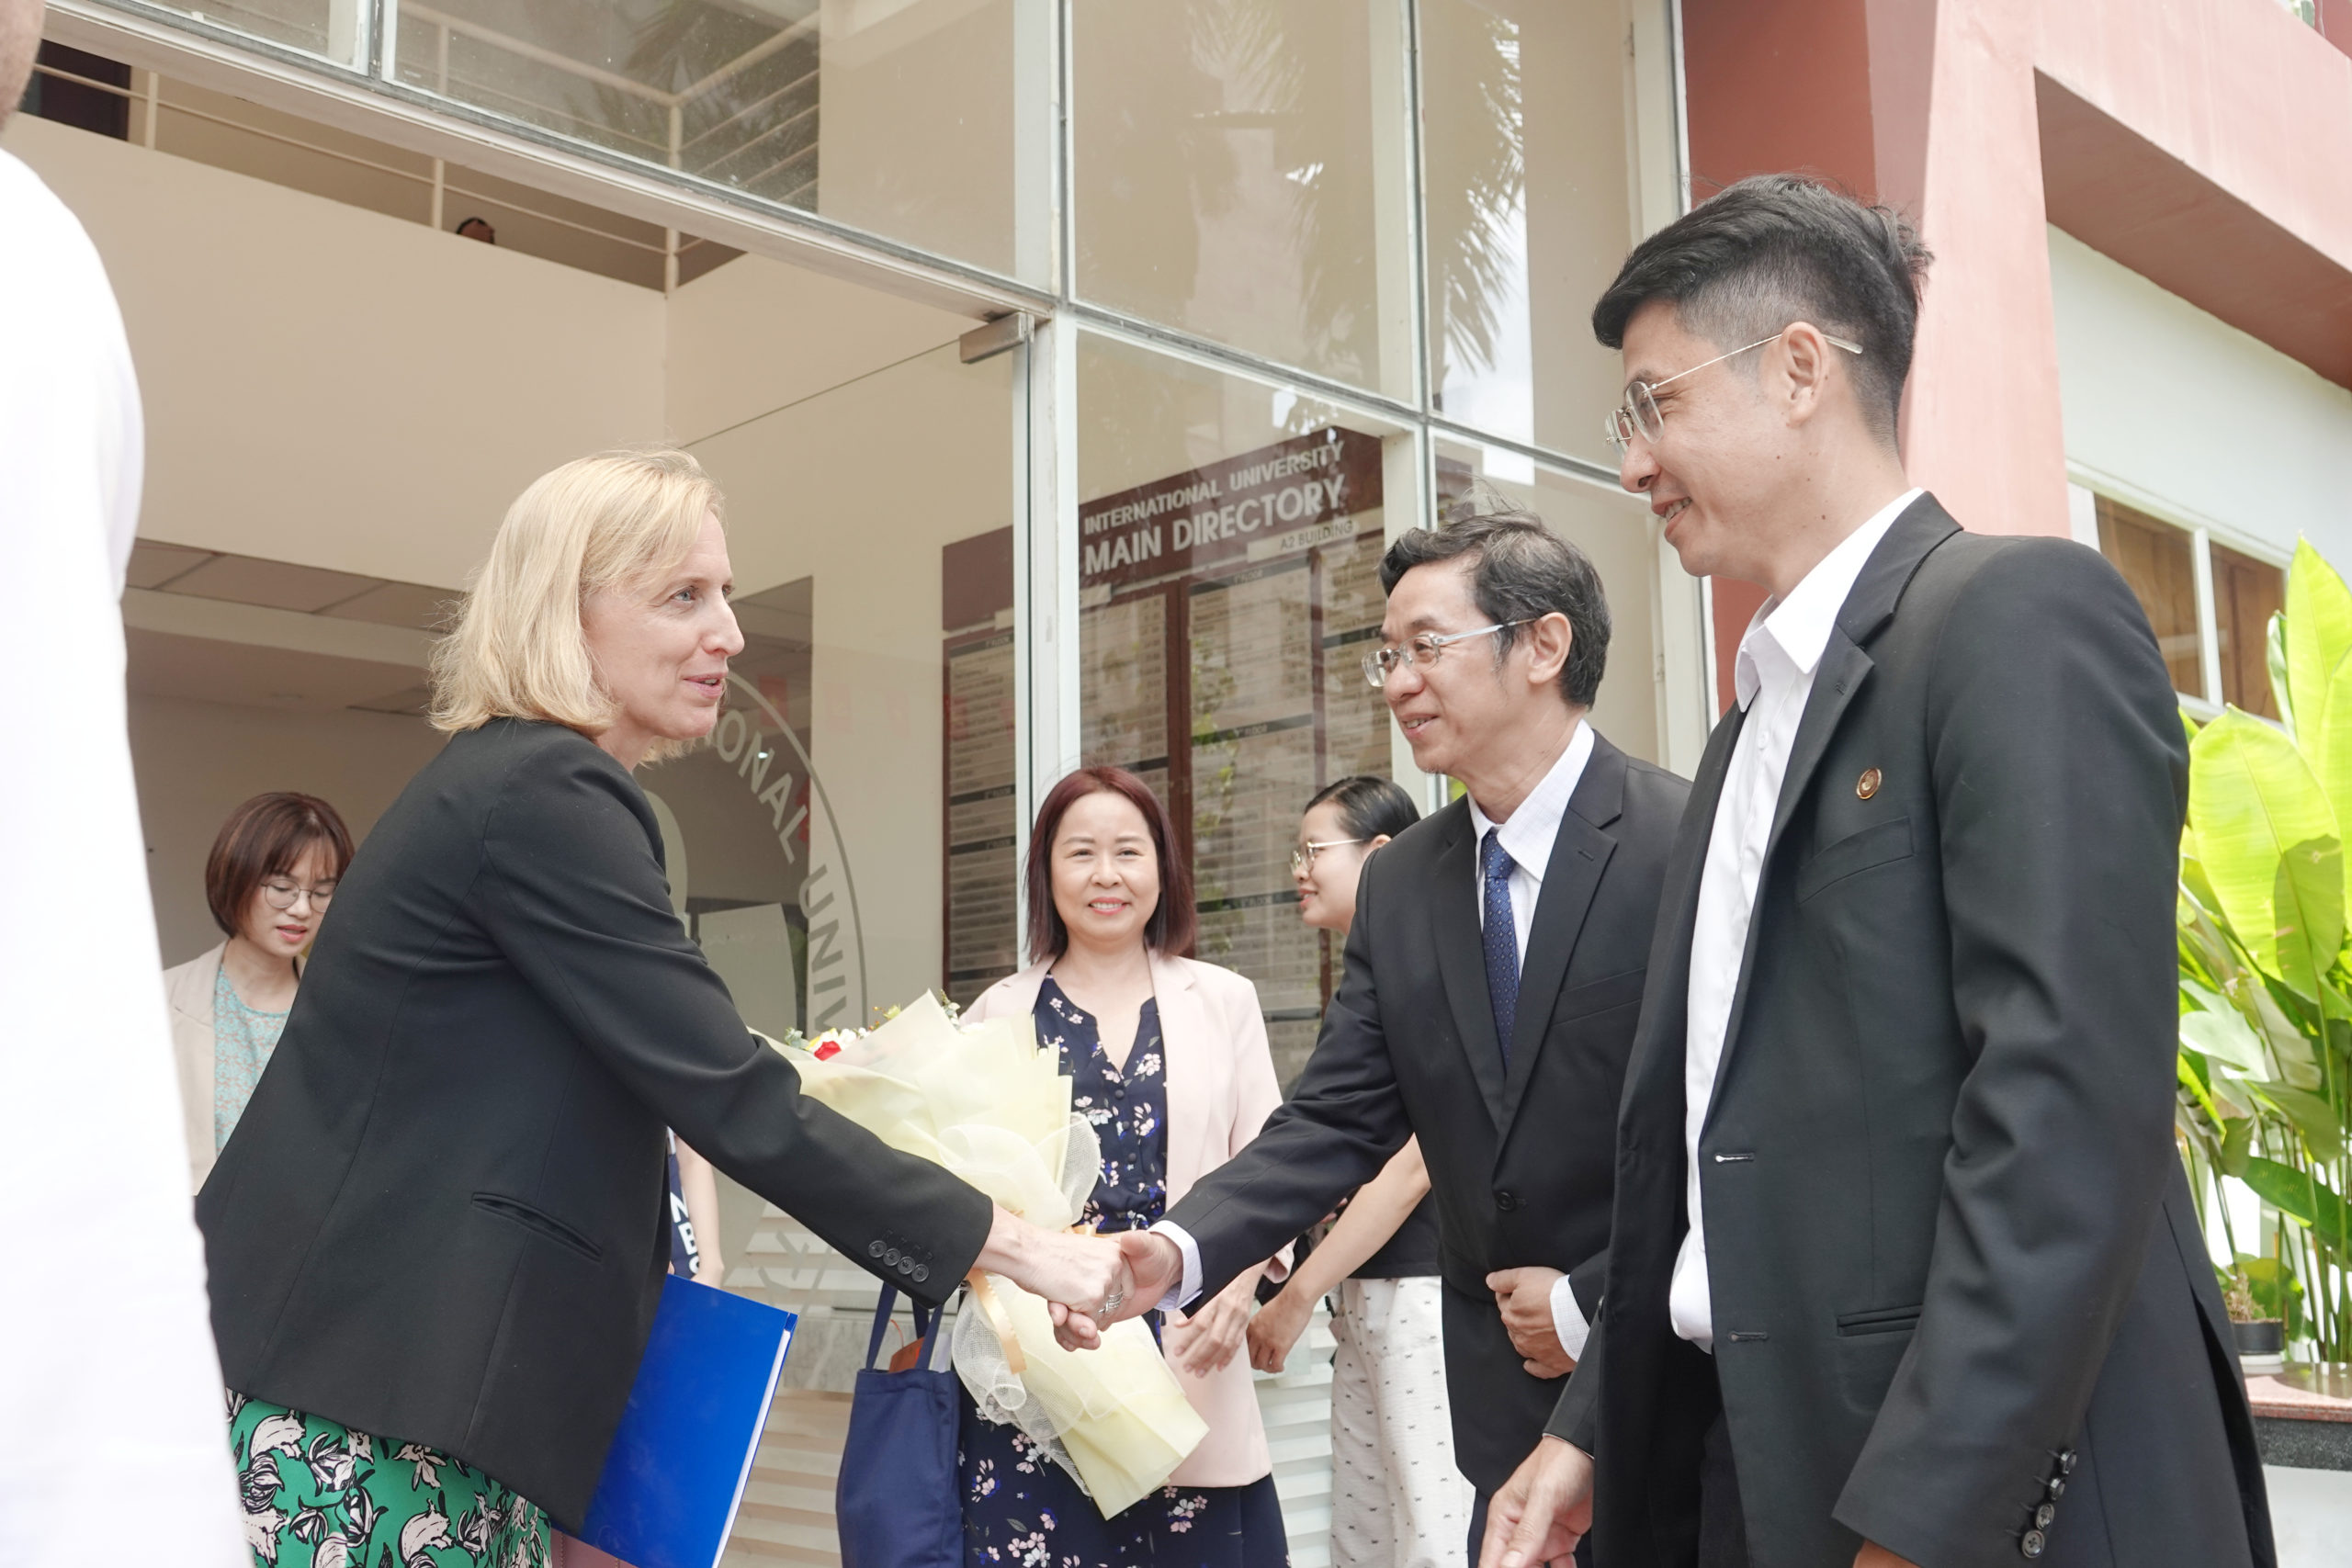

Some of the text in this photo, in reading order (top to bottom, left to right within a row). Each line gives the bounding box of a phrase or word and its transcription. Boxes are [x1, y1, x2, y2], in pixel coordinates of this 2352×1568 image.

[1084, 441, 1344, 535] INTERNATIONAL UNIVERSITY
[1084, 474, 1345, 575] MAIN DIRECTORY
[1280, 520, 1353, 551] A2 BUILDING
